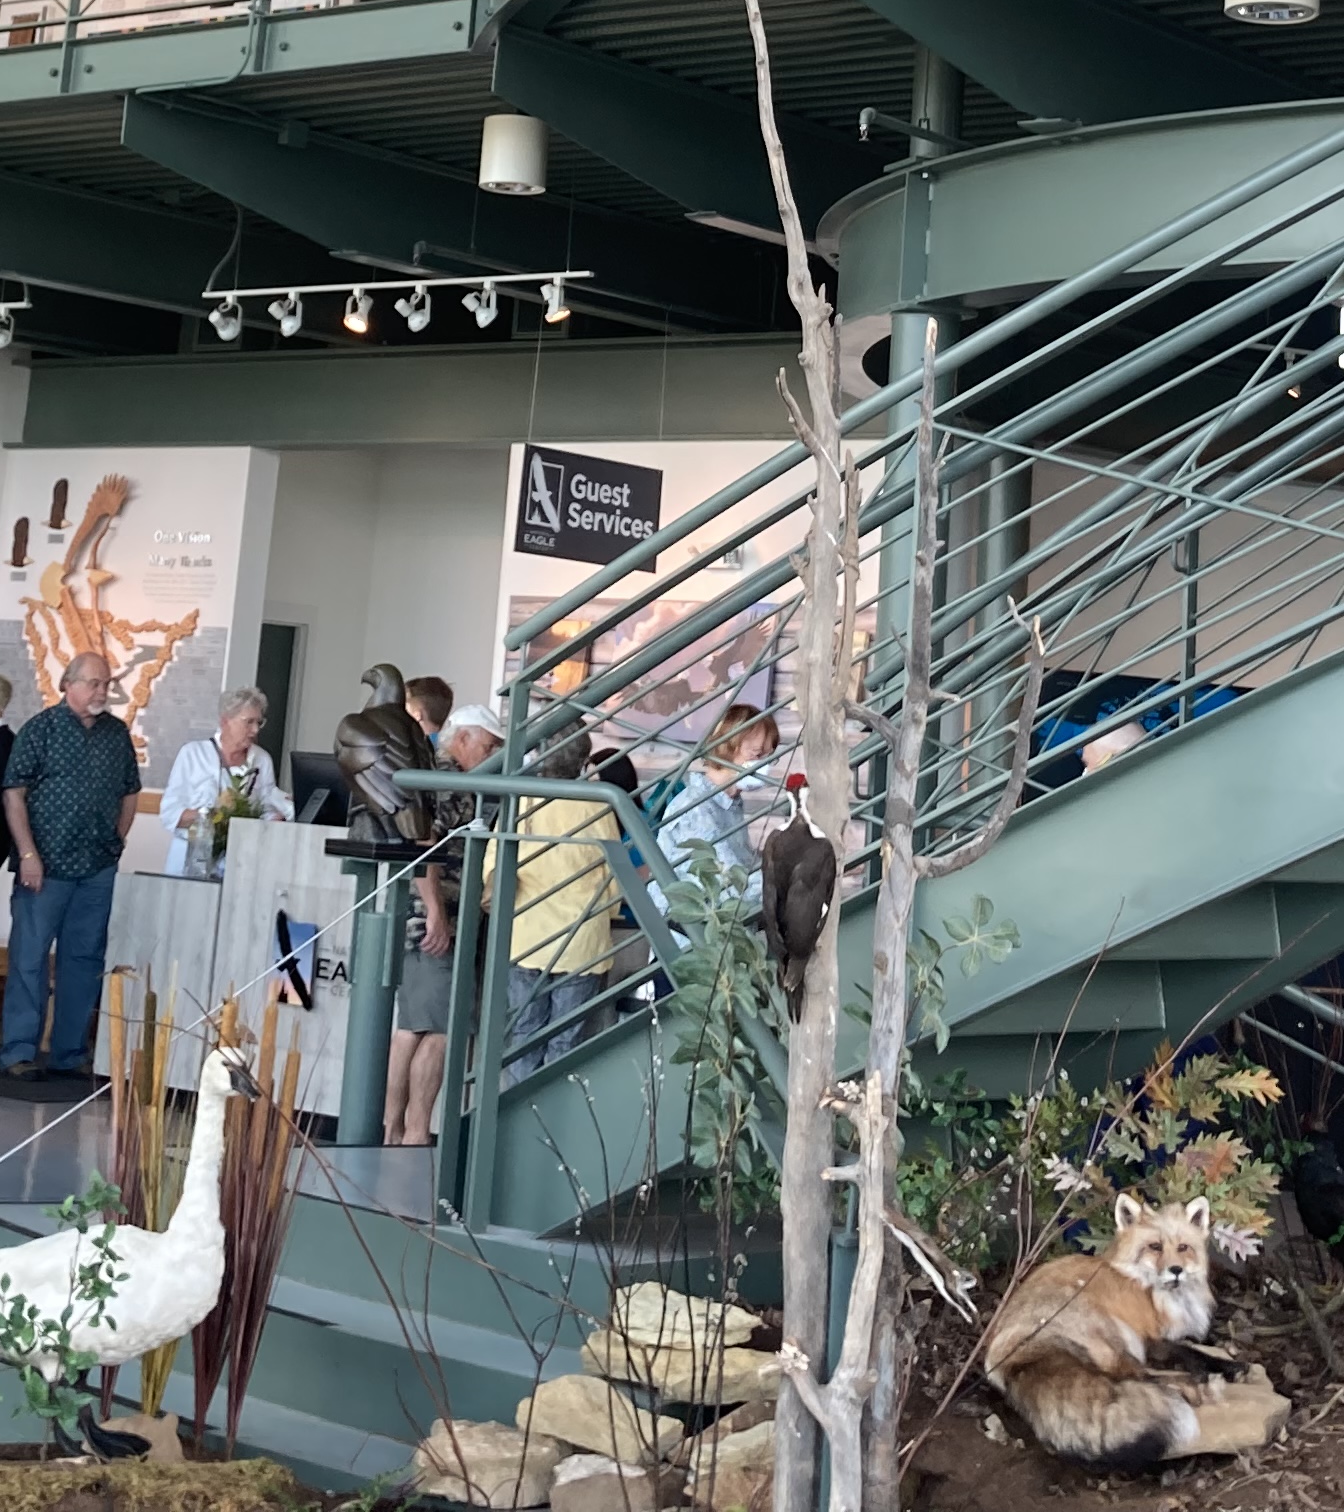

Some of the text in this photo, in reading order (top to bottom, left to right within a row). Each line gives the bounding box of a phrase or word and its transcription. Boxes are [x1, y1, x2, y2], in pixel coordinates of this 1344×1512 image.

[570, 473, 631, 508] Guest
[567, 501, 655, 541] Services
[523, 533, 556, 548] EAGLE
[316, 957, 348, 982] EA
